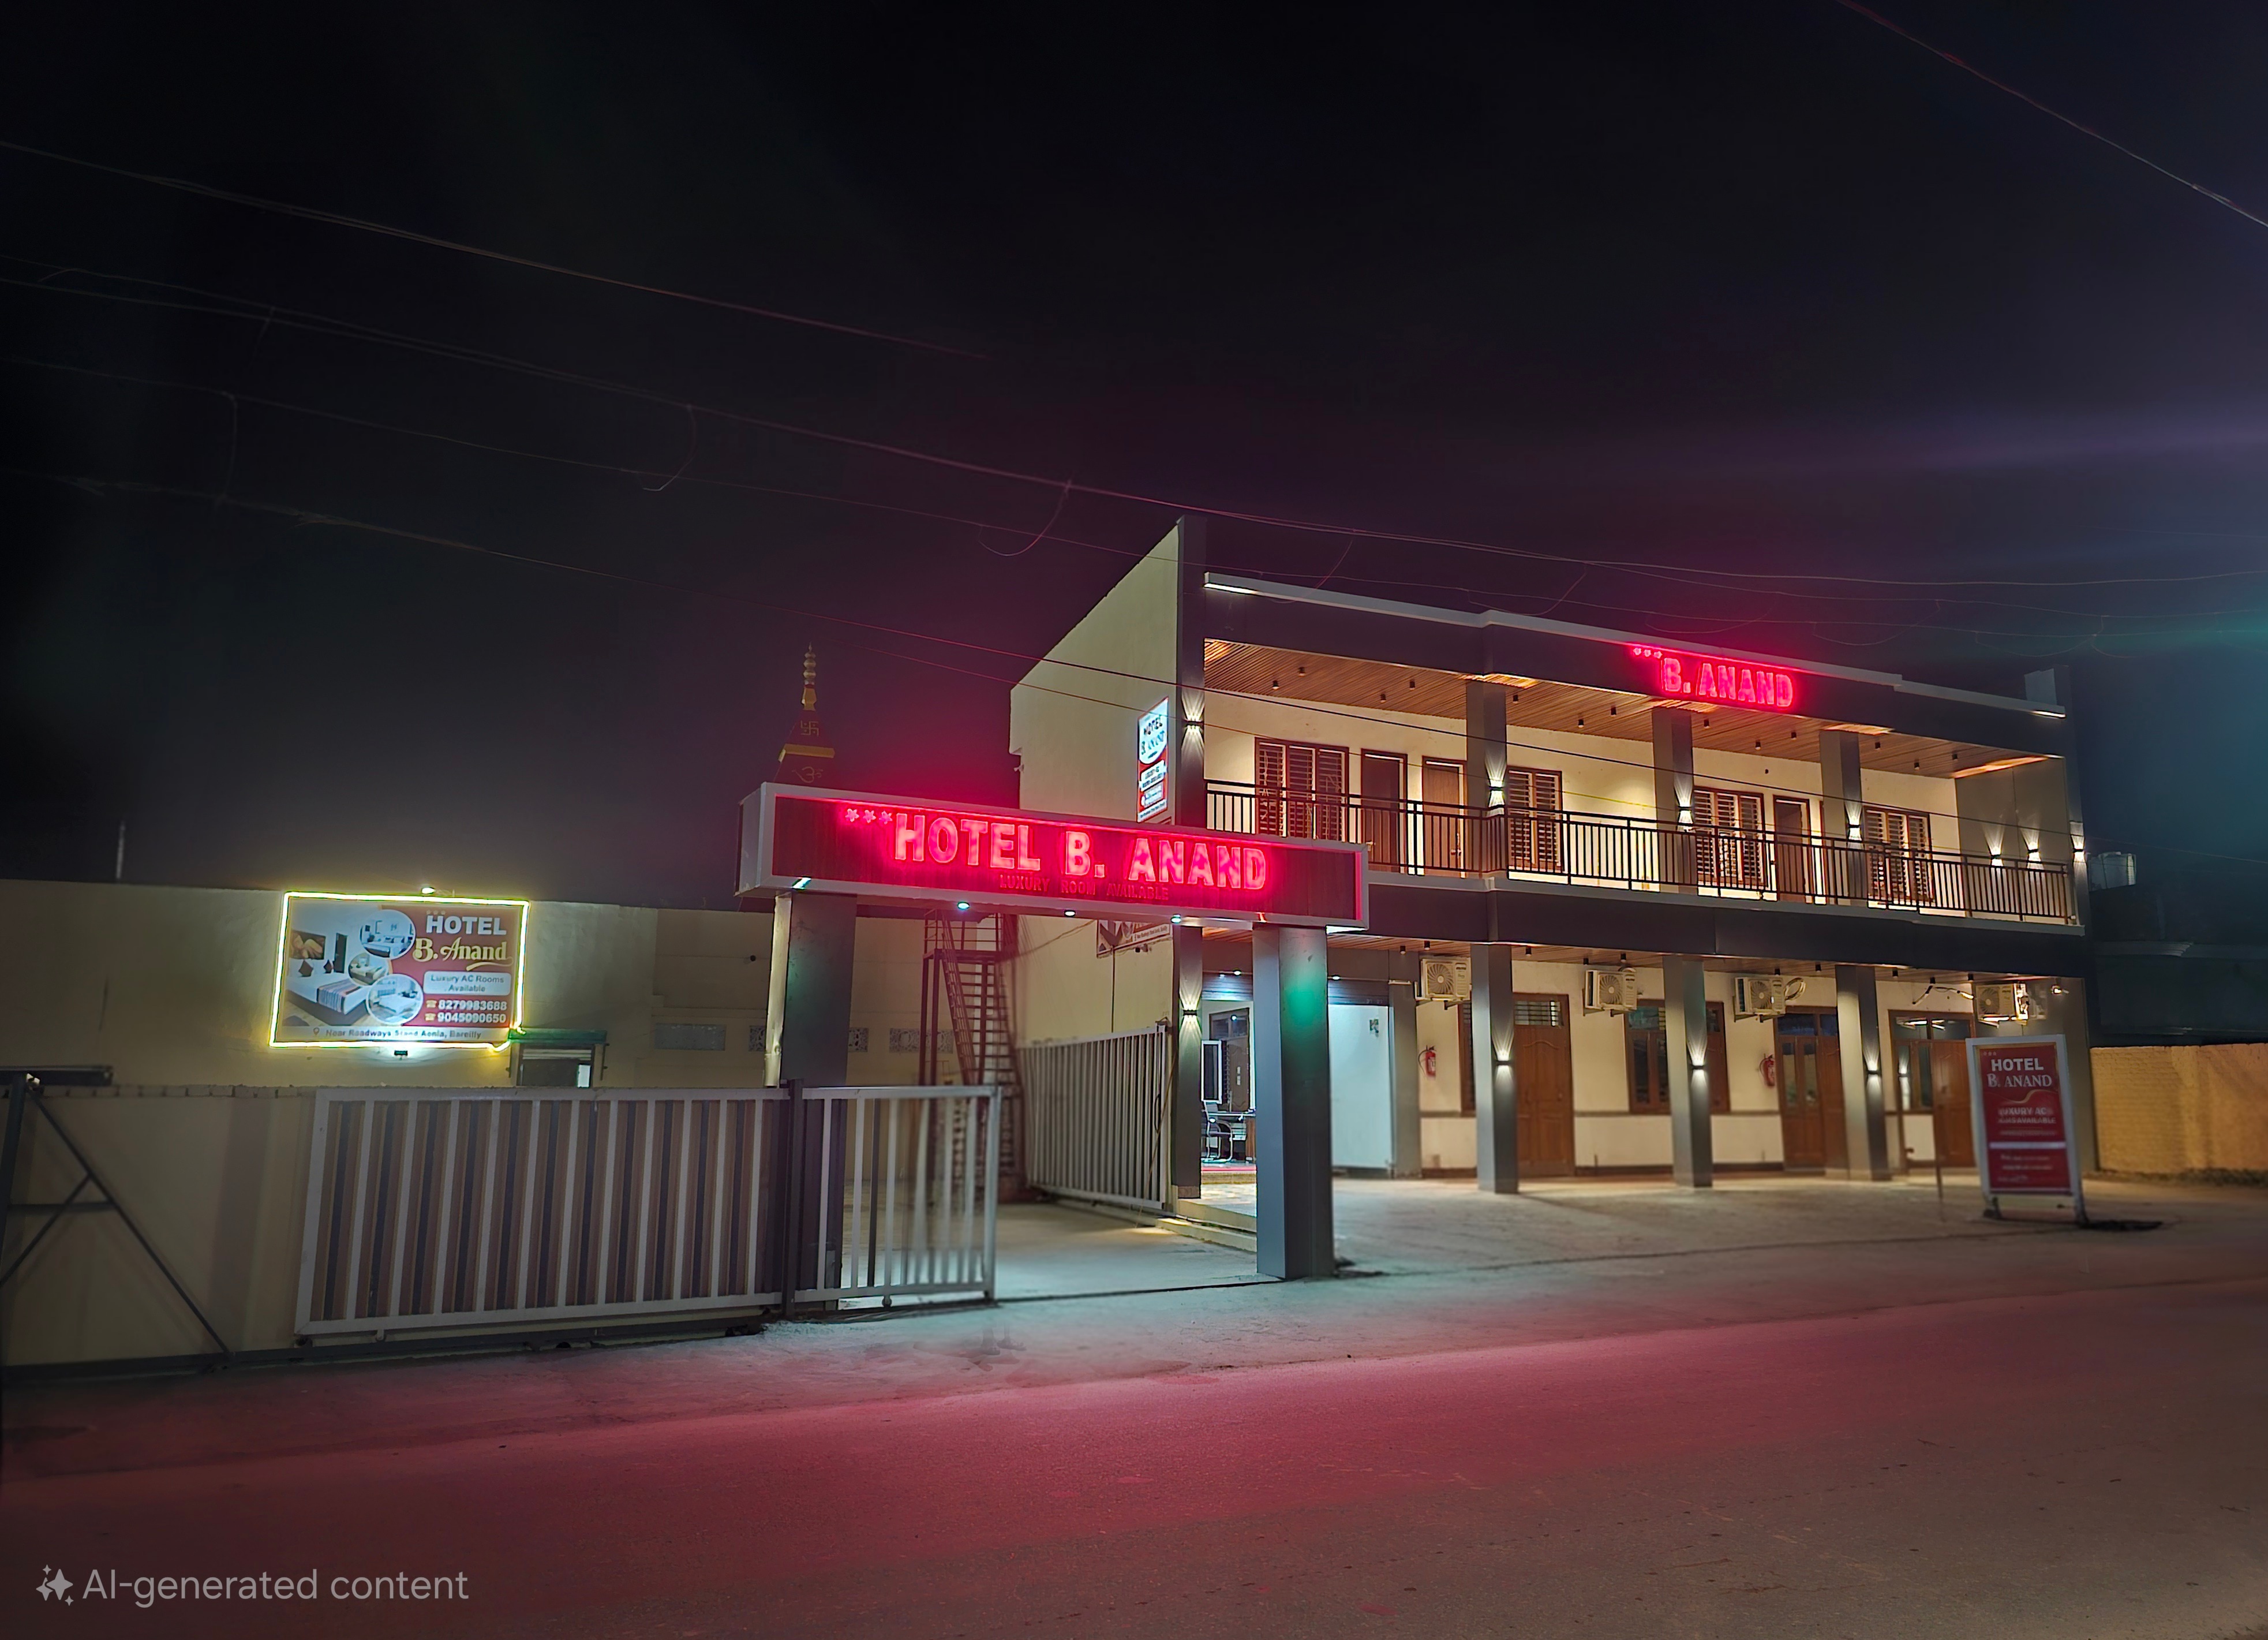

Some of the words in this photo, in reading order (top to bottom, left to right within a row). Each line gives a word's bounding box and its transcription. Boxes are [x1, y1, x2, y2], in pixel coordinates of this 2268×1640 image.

[1663, 658, 1691, 693] B.
[1698, 663, 1793, 707] ANAND
[895, 812, 1041, 871] HOTEL
[1065, 831, 1105, 878] B.
[1128, 838, 1266, 890] ANAND
[1000, 874, 1050, 892] LUXURY
[1061, 880, 1096, 895] ROOM
[1106, 883, 1169, 901] AVAILABLE
[426, 915, 507, 935] HOTEL
[412, 937, 439, 962] B.
[440, 936, 510, 963] Anand
[431, 974, 459, 983] Luxury
[448, 984, 485, 992] Available
[349, 1029, 391, 1038] Roadways
[450, 1030, 482, 1039] Bareilly
[1990, 1058, 2044, 1071] HOTEL
[1986, 1073, 2001, 1088] B.
[2004, 1074, 2052, 1088] ANAND
[2035, 1107, 2046, 1115] AC
